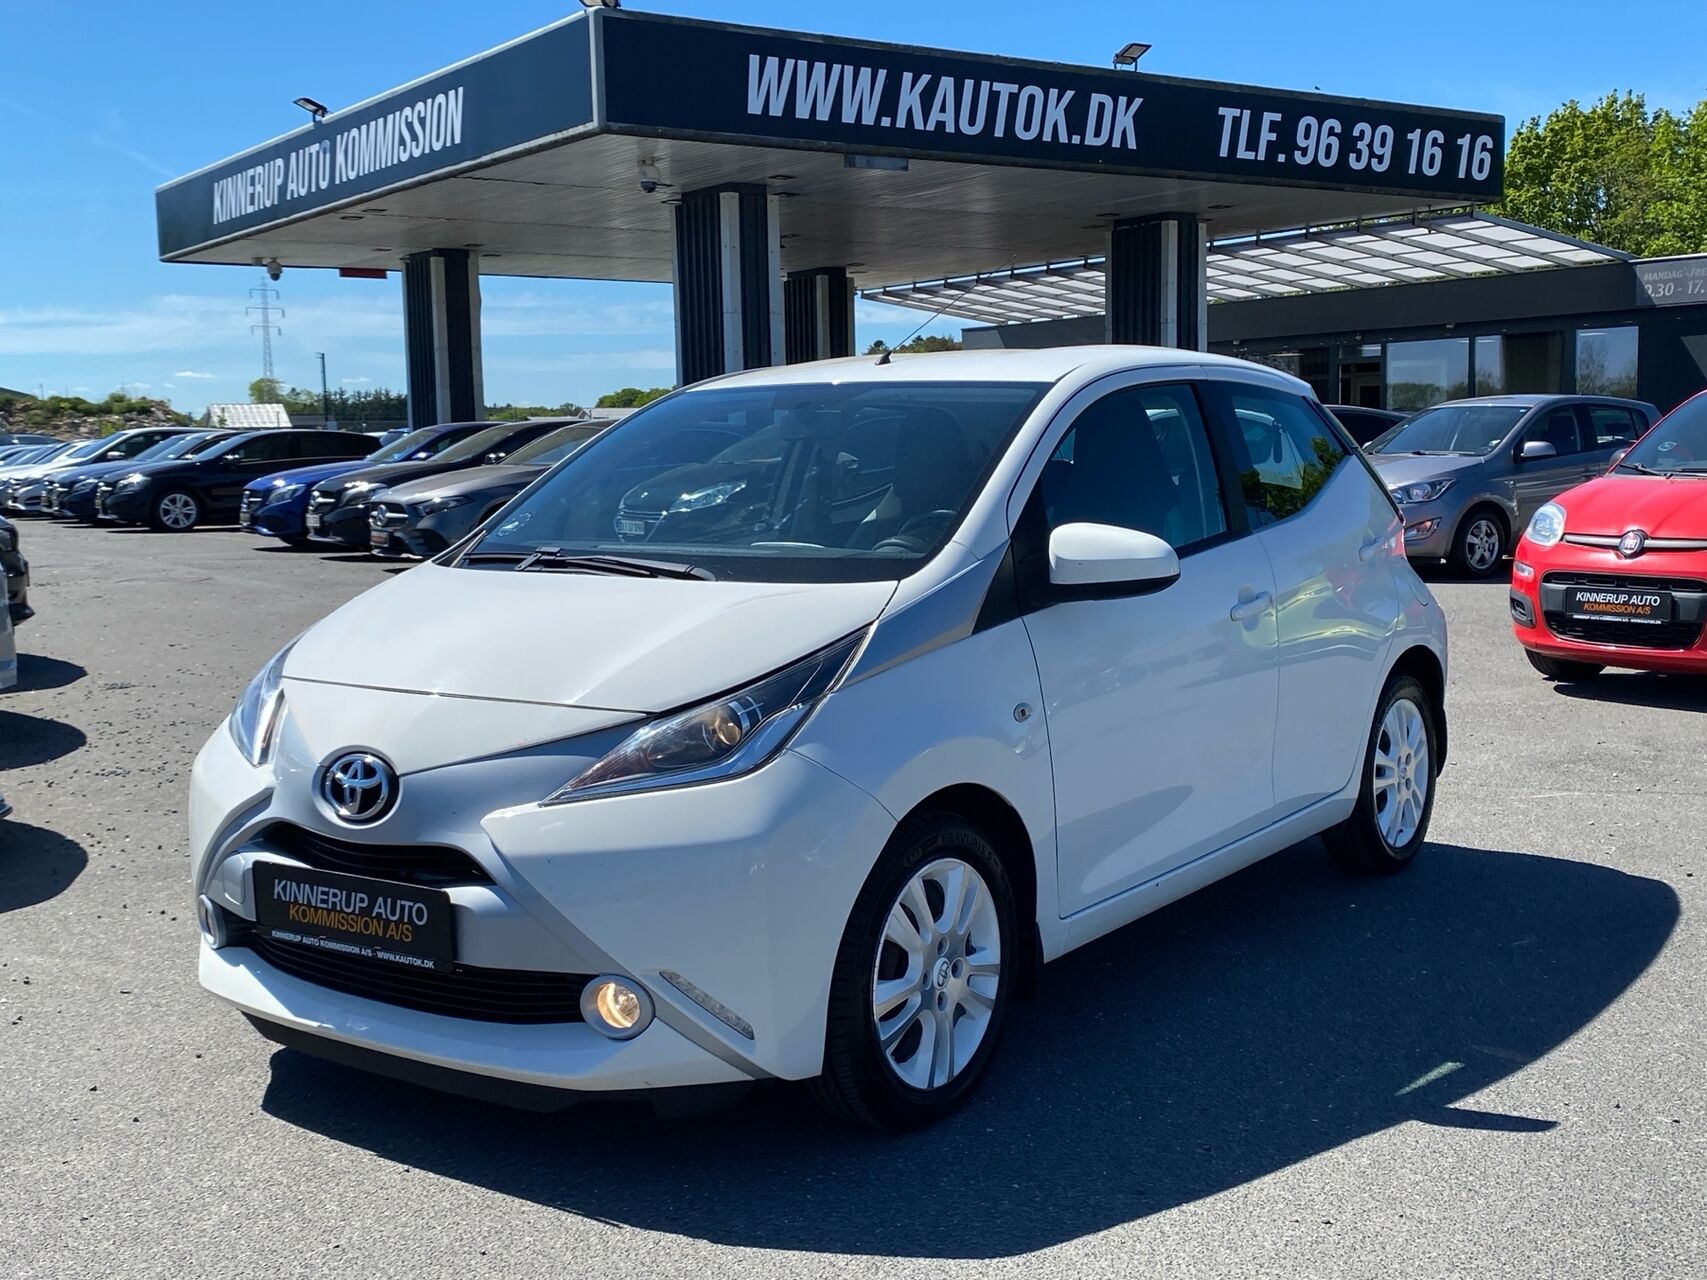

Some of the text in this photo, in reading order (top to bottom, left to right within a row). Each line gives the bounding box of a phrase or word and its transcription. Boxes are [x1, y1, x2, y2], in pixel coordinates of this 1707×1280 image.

[747, 54, 1494, 181] WWW.KAUTOK.DK TLF. 96 39 16 16
[213, 86, 464, 225] KINNERUP AUTO KOMMISSION
[1643, 270, 1683, 281] MANDAG
[1576, 592, 1661, 606] KINNERUP AUTO
[1583, 603, 1651, 615] KOMMISSION A/S
[274, 879, 428, 926] KINNERUP AUTO
[289, 904, 413, 942] KOMMISSION A/S
[302, 937, 319, 946] AUTO
